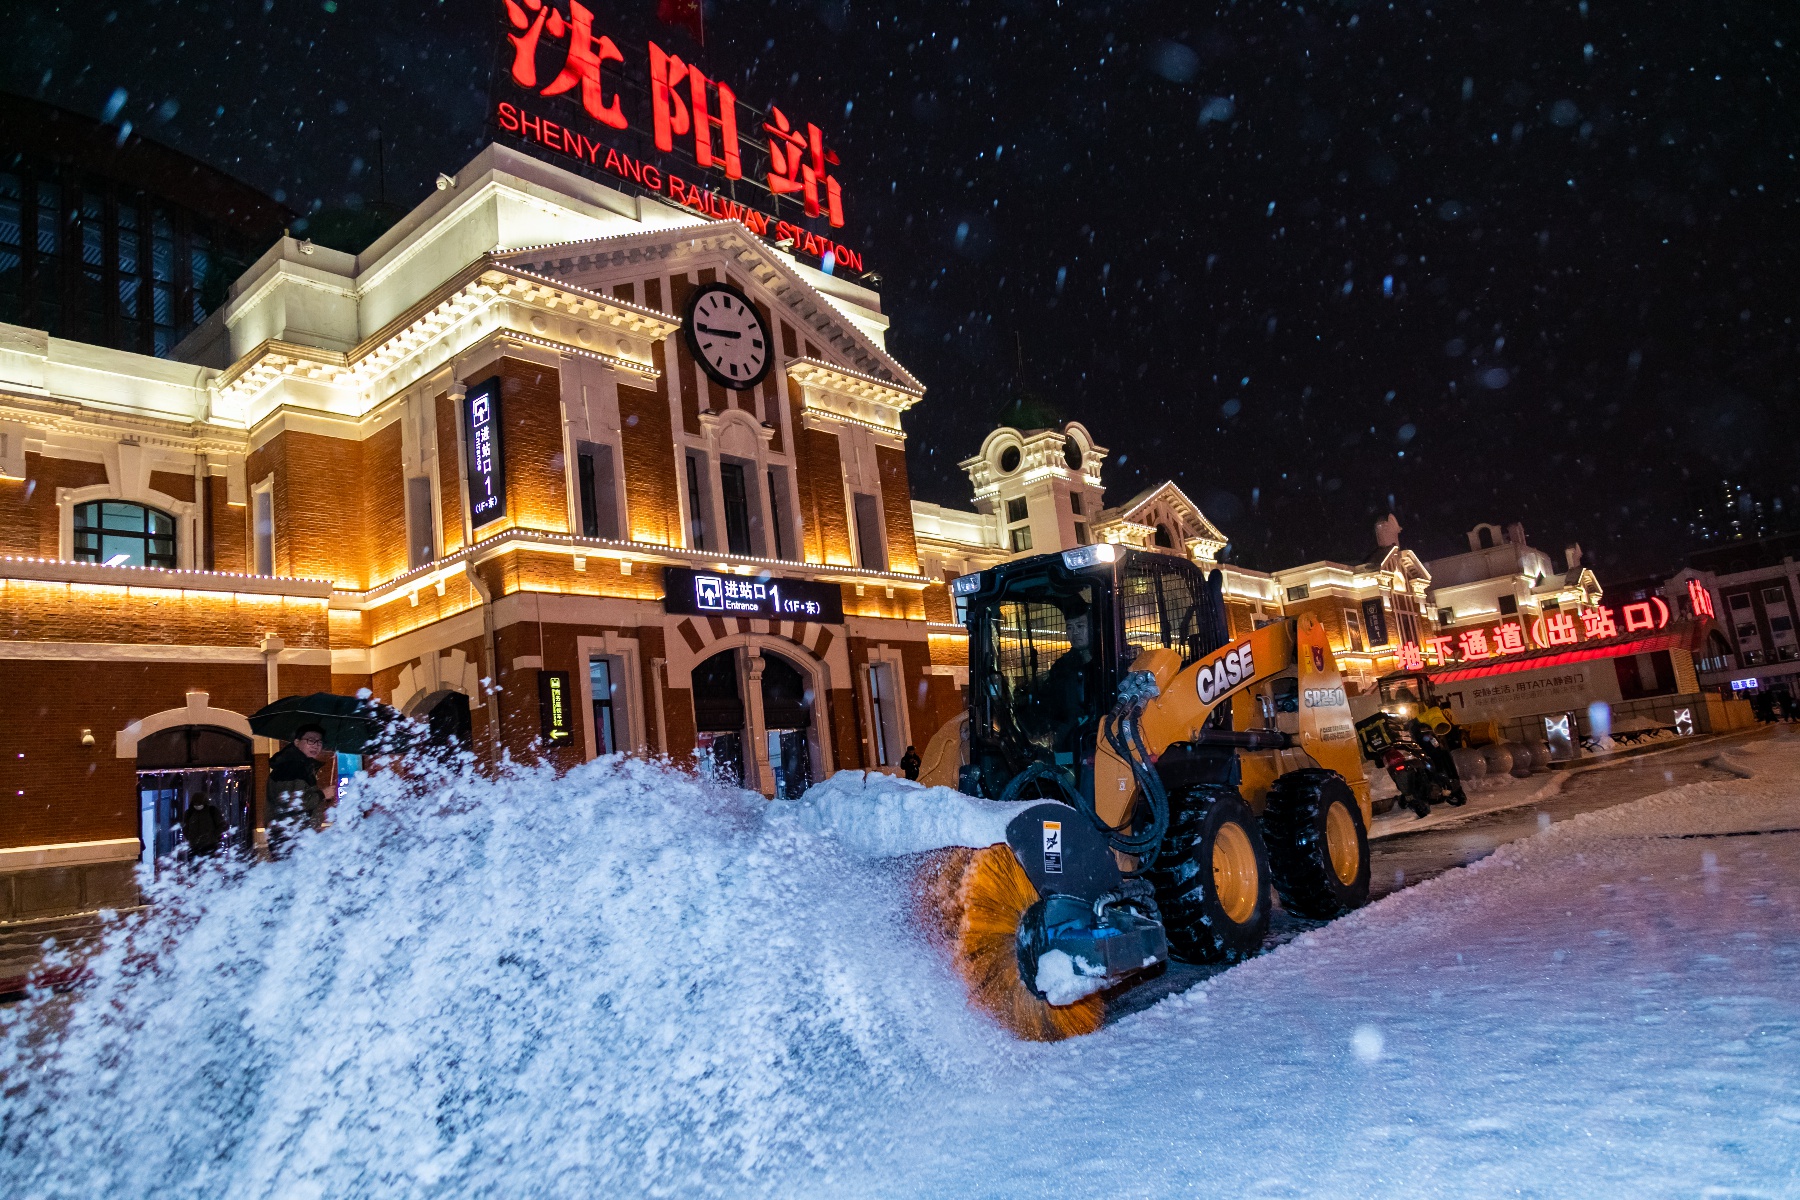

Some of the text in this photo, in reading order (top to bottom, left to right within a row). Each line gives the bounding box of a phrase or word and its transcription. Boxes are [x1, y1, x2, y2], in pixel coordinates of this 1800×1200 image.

[505, 0, 845, 228] 沈阳站
[498, 102, 863, 272] SHENYANG RAILWAY STATION
[725, 600, 758, 611] Entrance
[1196, 642, 1254, 704] CASE
[1304, 688, 1345, 708] SR250
